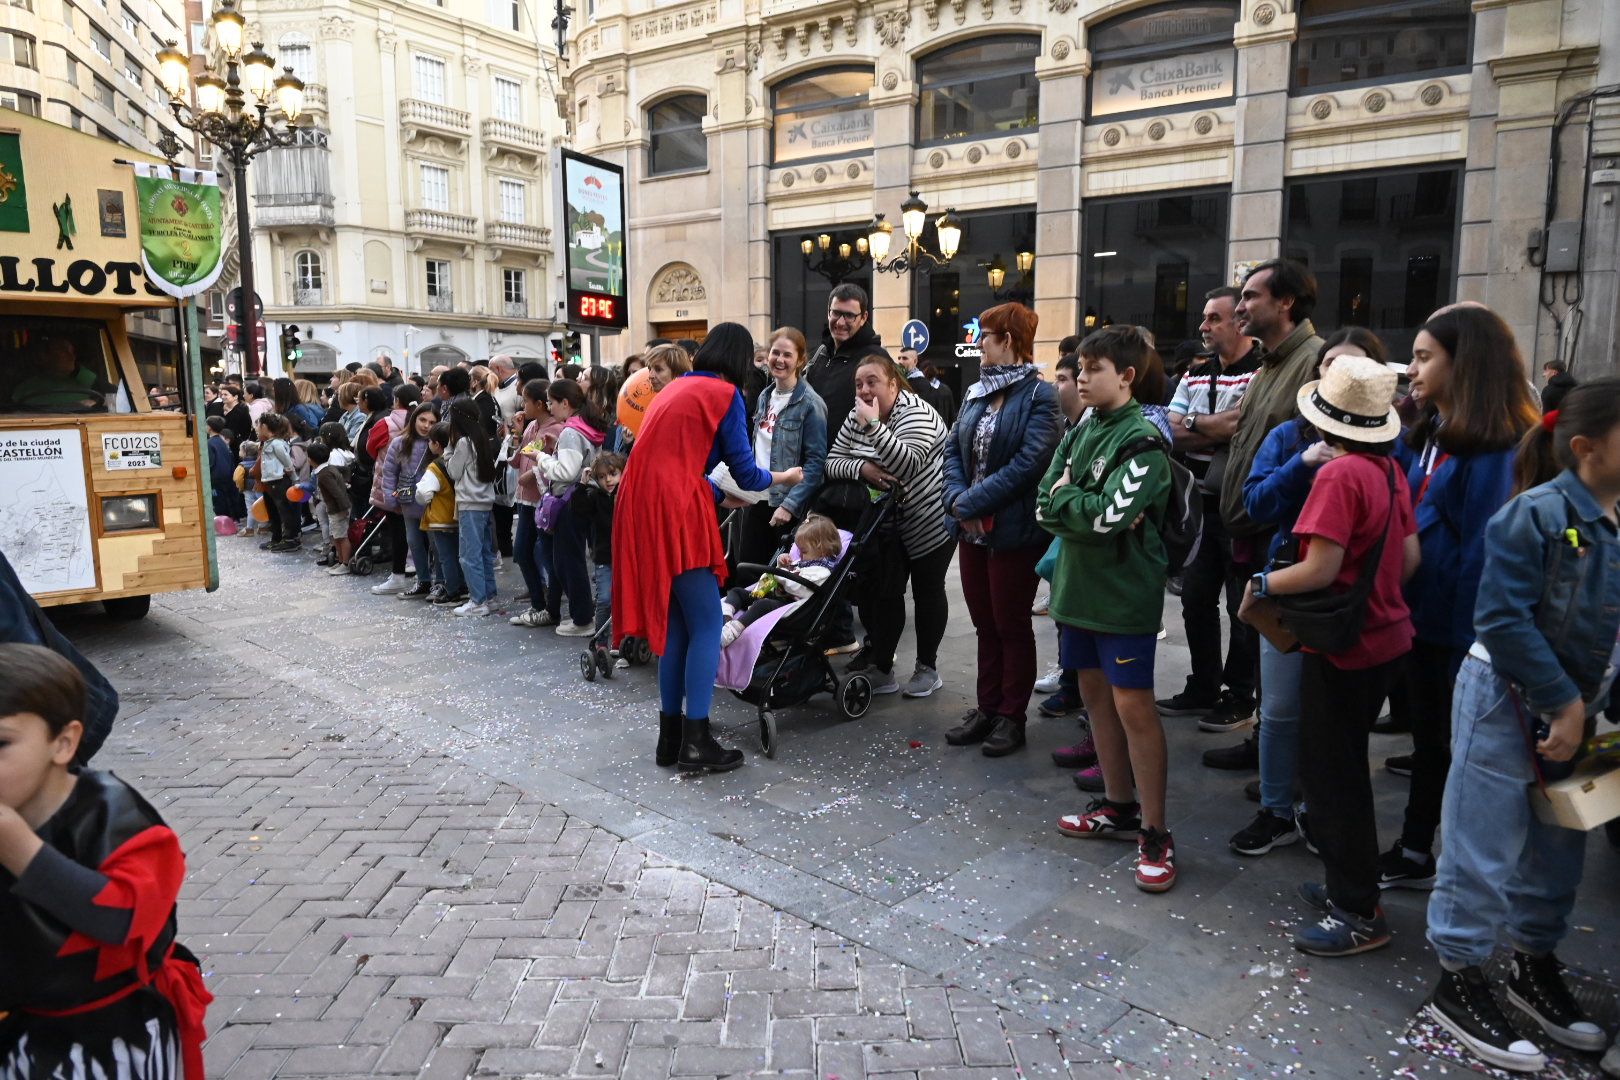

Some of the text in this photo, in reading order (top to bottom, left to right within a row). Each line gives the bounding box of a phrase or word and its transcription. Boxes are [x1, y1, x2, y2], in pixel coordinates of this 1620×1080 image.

[1140, 60, 1223, 84] CaixaBank
[1140, 81, 1223, 101] Banca Premier
[810, 113, 870, 135] CaixaBank
[811, 134, 870, 149] Banca Premier
[5, 440, 18, 448] de
[19, 439, 28, 447] la
[30, 438, 61, 446] ciudad
[104, 436, 158, 450] FC012CS
